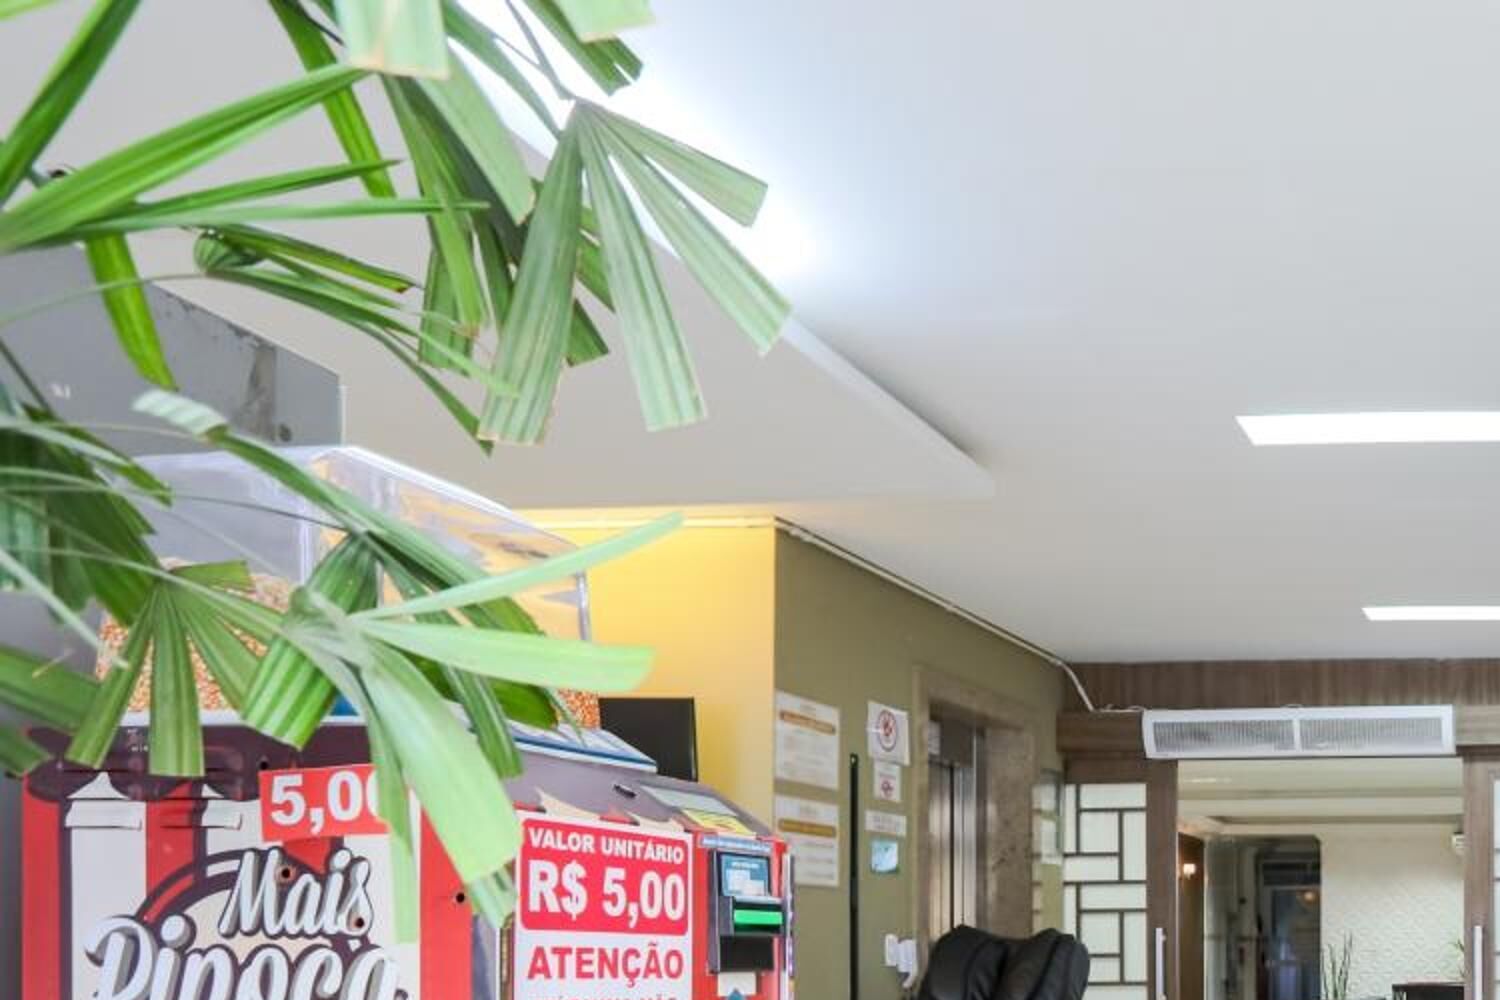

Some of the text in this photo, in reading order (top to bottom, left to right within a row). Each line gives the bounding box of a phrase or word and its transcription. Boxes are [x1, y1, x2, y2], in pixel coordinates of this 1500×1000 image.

[271, 770, 376, 834] 5,0
[528, 827, 595, 854] VALOR
[600, 836, 685, 865] UNITÁRIO
[218, 848, 373, 939] Mais
[527, 859, 686, 928] R$ 5,00
[526, 942, 685, 988] ATENÇÃO
